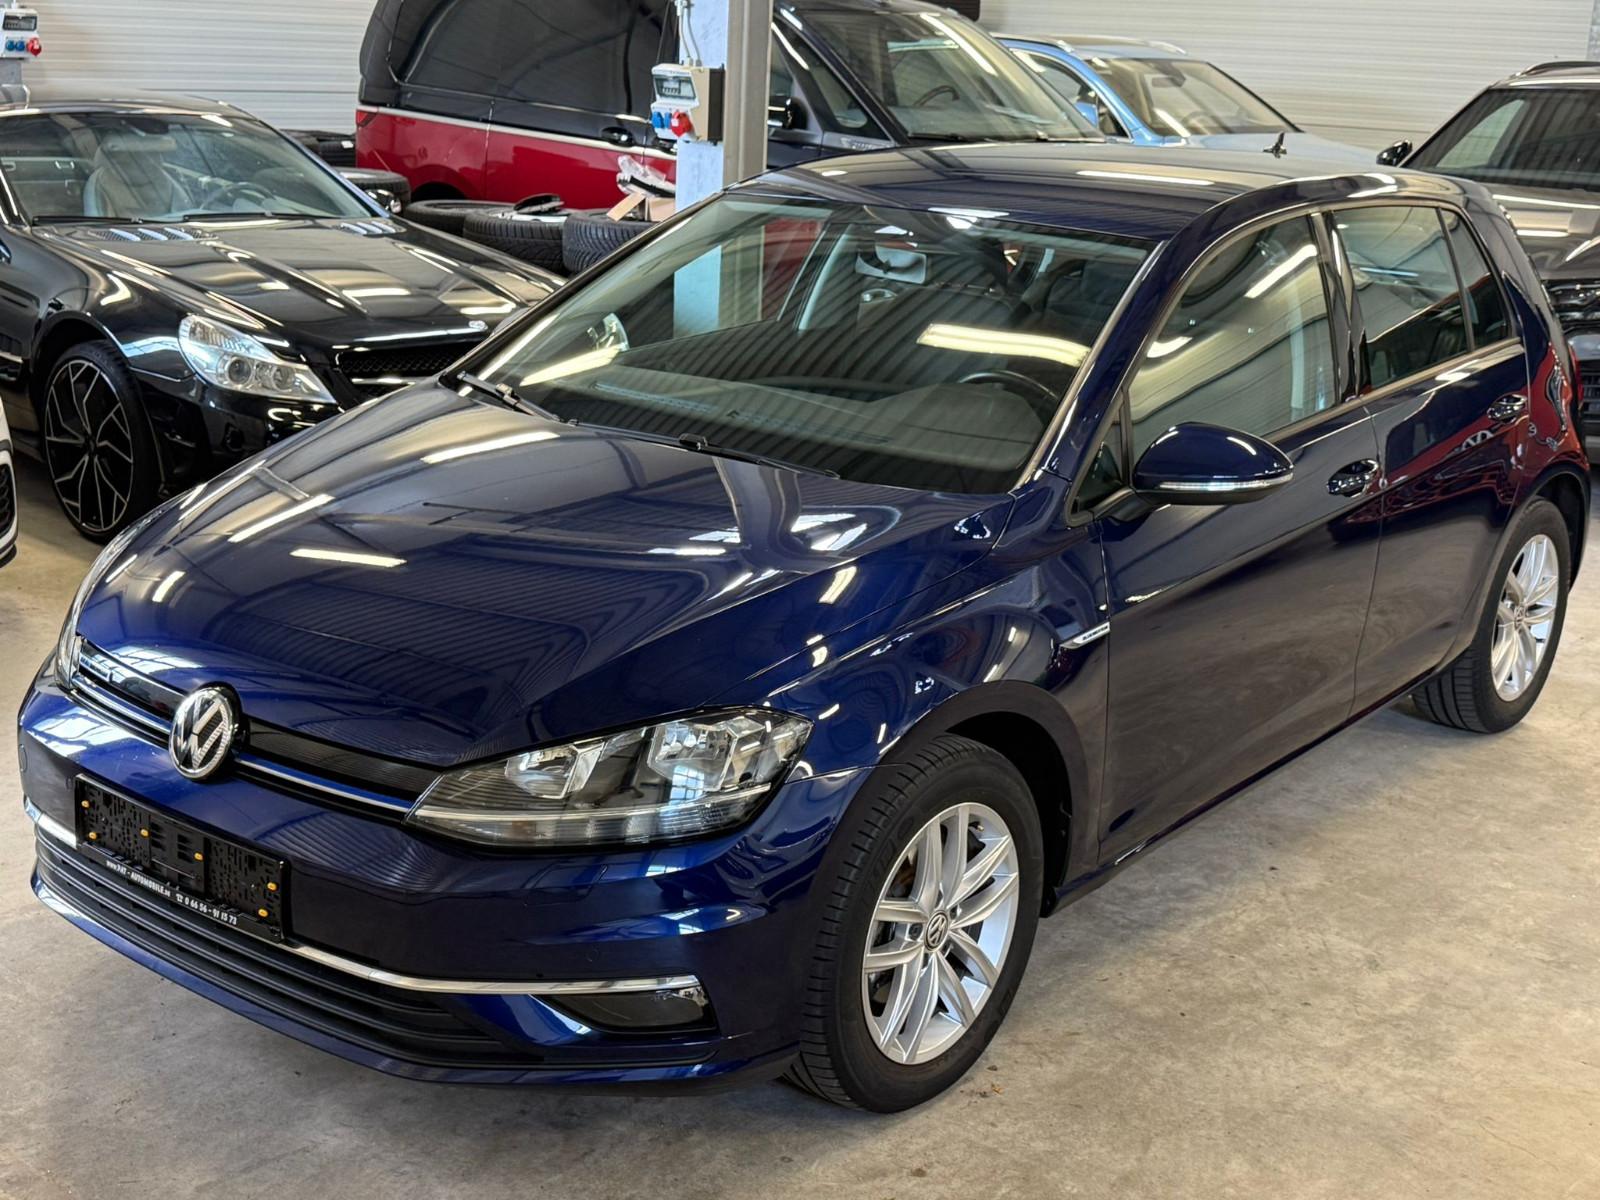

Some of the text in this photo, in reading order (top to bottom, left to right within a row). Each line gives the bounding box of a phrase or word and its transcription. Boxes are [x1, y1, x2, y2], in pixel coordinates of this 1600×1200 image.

[184, 896, 190, 905] 0
[190, 899, 198, 909] 66
[199, 902, 207, 913] 56
[228, 915, 237, 925] 73
